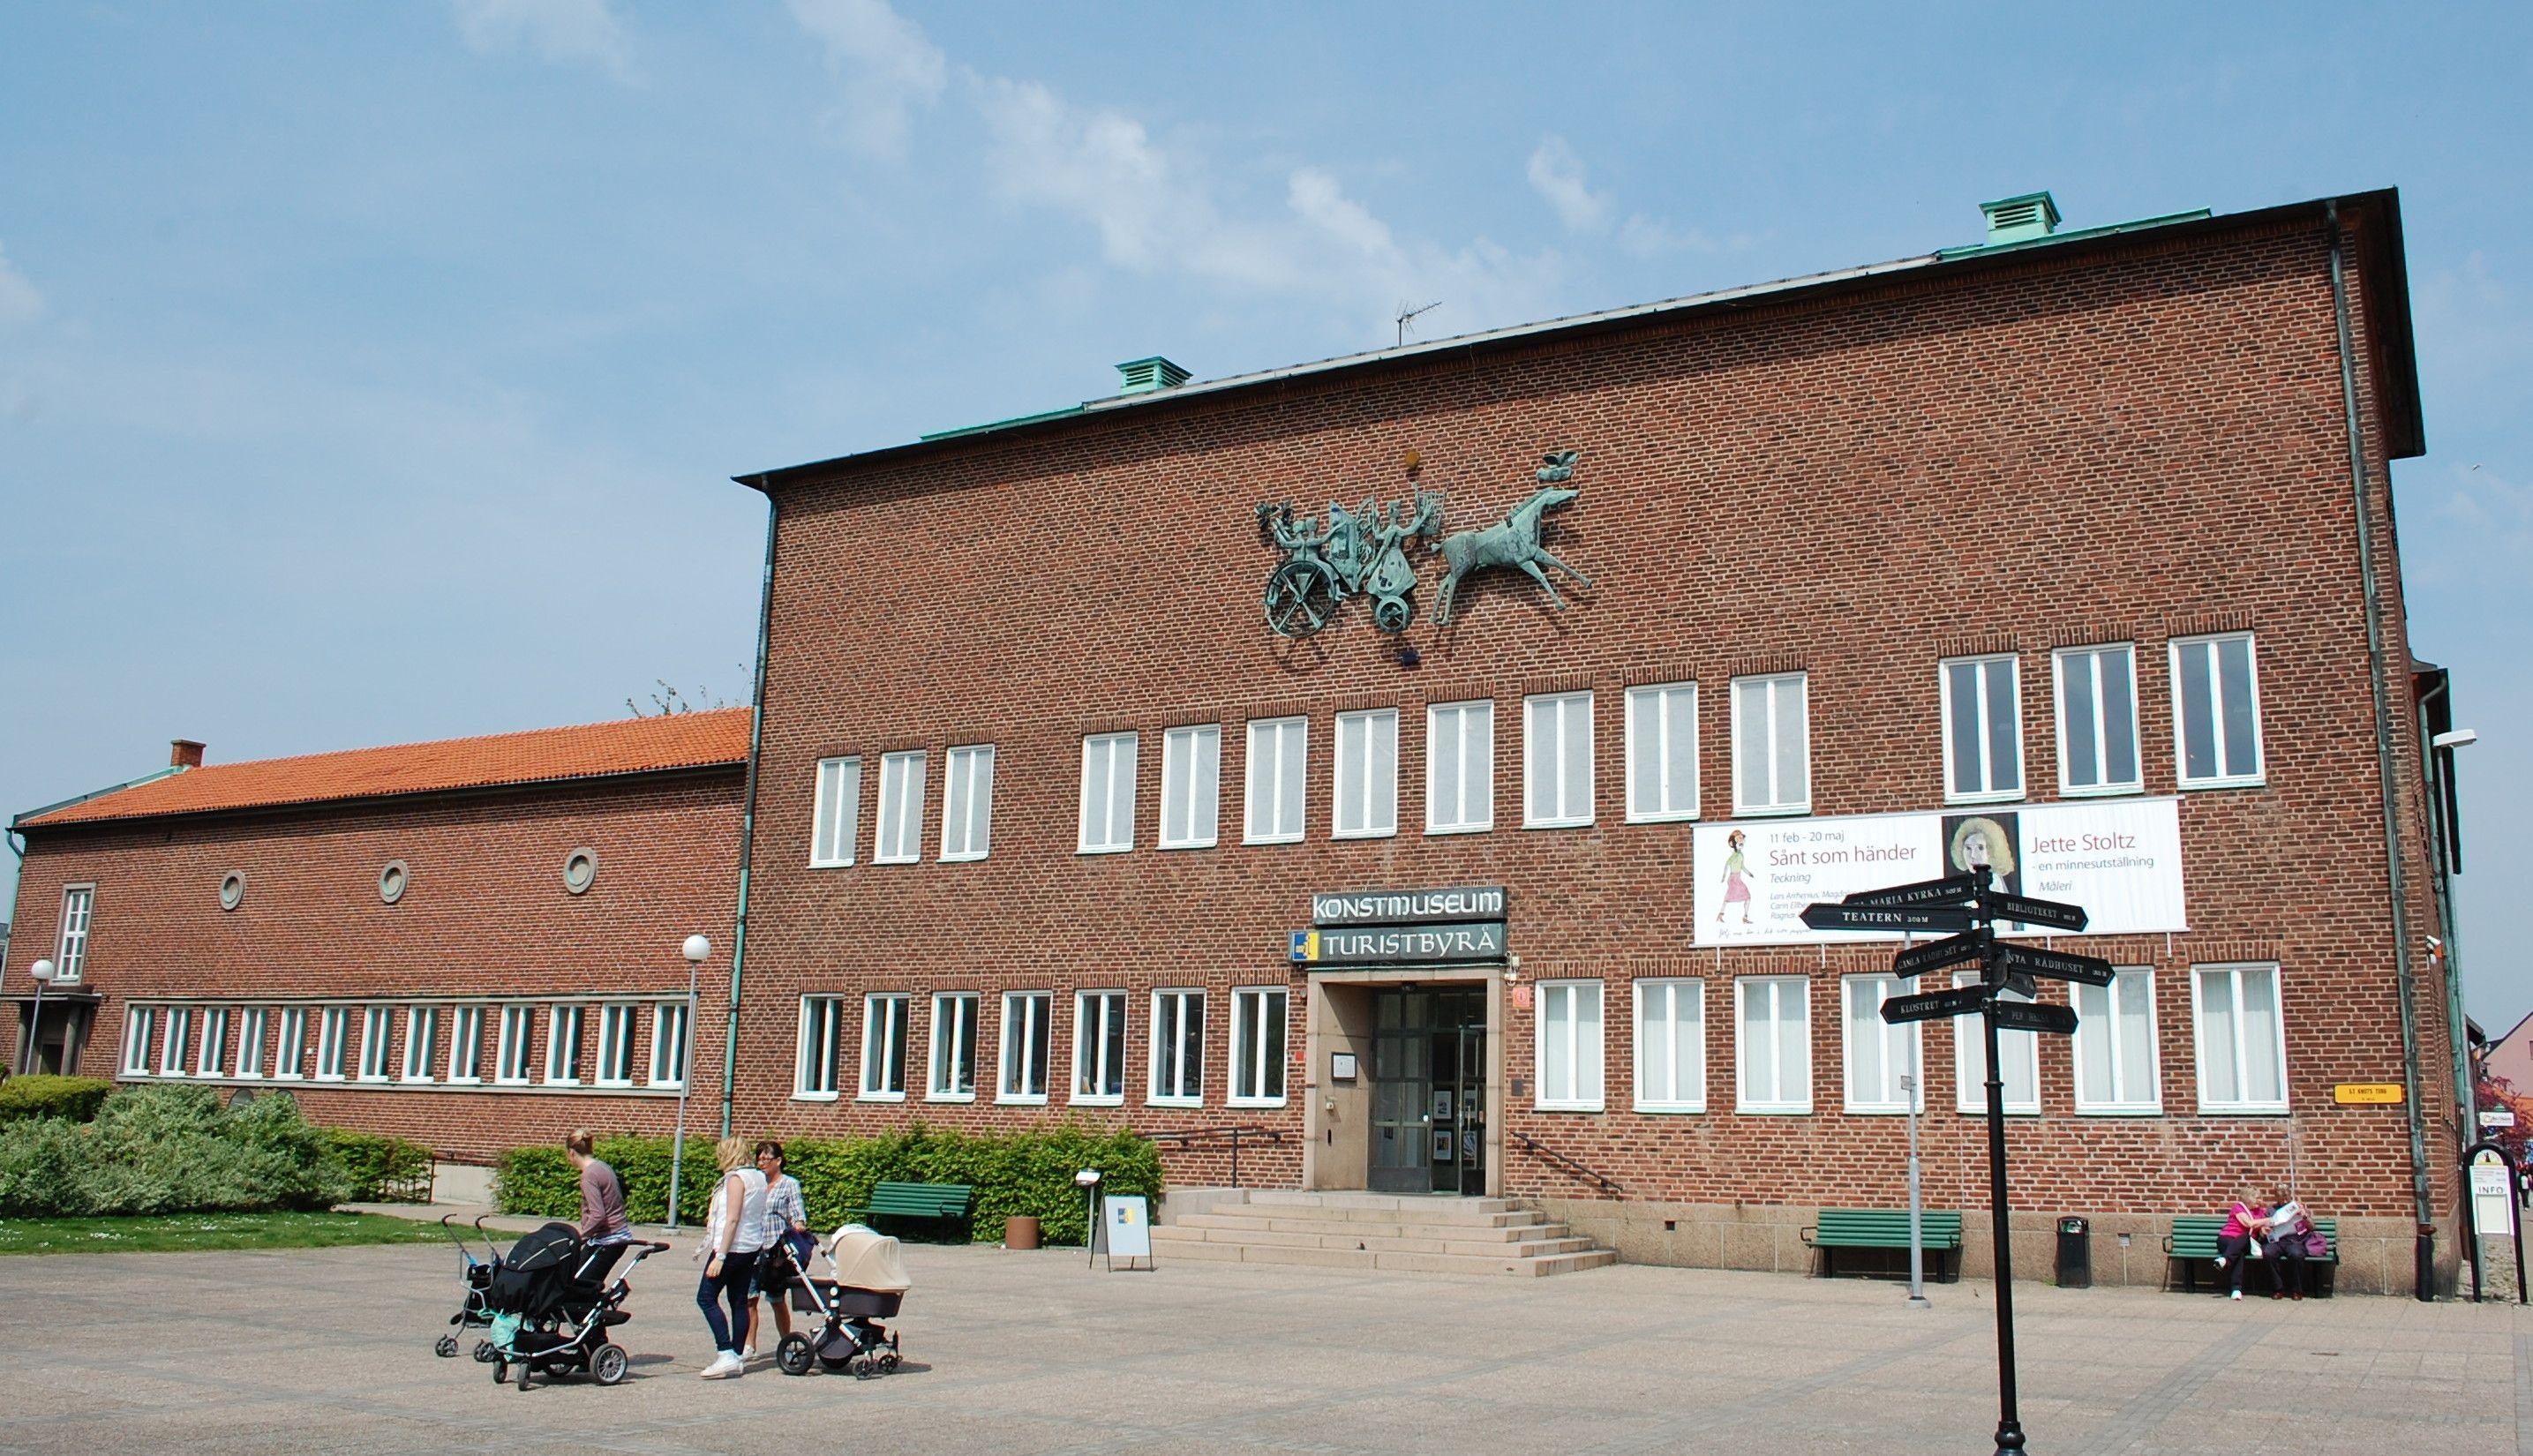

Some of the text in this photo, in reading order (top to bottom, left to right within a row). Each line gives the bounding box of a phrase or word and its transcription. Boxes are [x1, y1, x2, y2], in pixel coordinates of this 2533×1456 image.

[1770, 833, 1778, 843] 11
[1783, 832, 1800, 843] feb
[1809, 831, 1822, 842] 20
[1824, 830, 1845, 843] maj
[2031, 831, 2136, 853] Jette Stoltz
[1770, 844, 1917, 867] Sånt som händer
[2039, 862, 2053, 871] en
[2056, 856, 2154, 871] minnesutställning
[1770, 873, 1811, 884] Teckning
[2039, 880, 2073, 892] Måleri
[1907, 888, 1942, 902] KYRKA
[1312, 891, 1501, 919] KONSTMUSEUM
[2007, 902, 2057, 919] BIBLIOTEKET
[1843, 912, 1902, 923] TEATERN
[1323, 926, 1496, 957] TURISTBYRÅ
[2006, 952, 2026, 964] NYA
[1900, 1000, 1939, 1014] KLOSTRET
